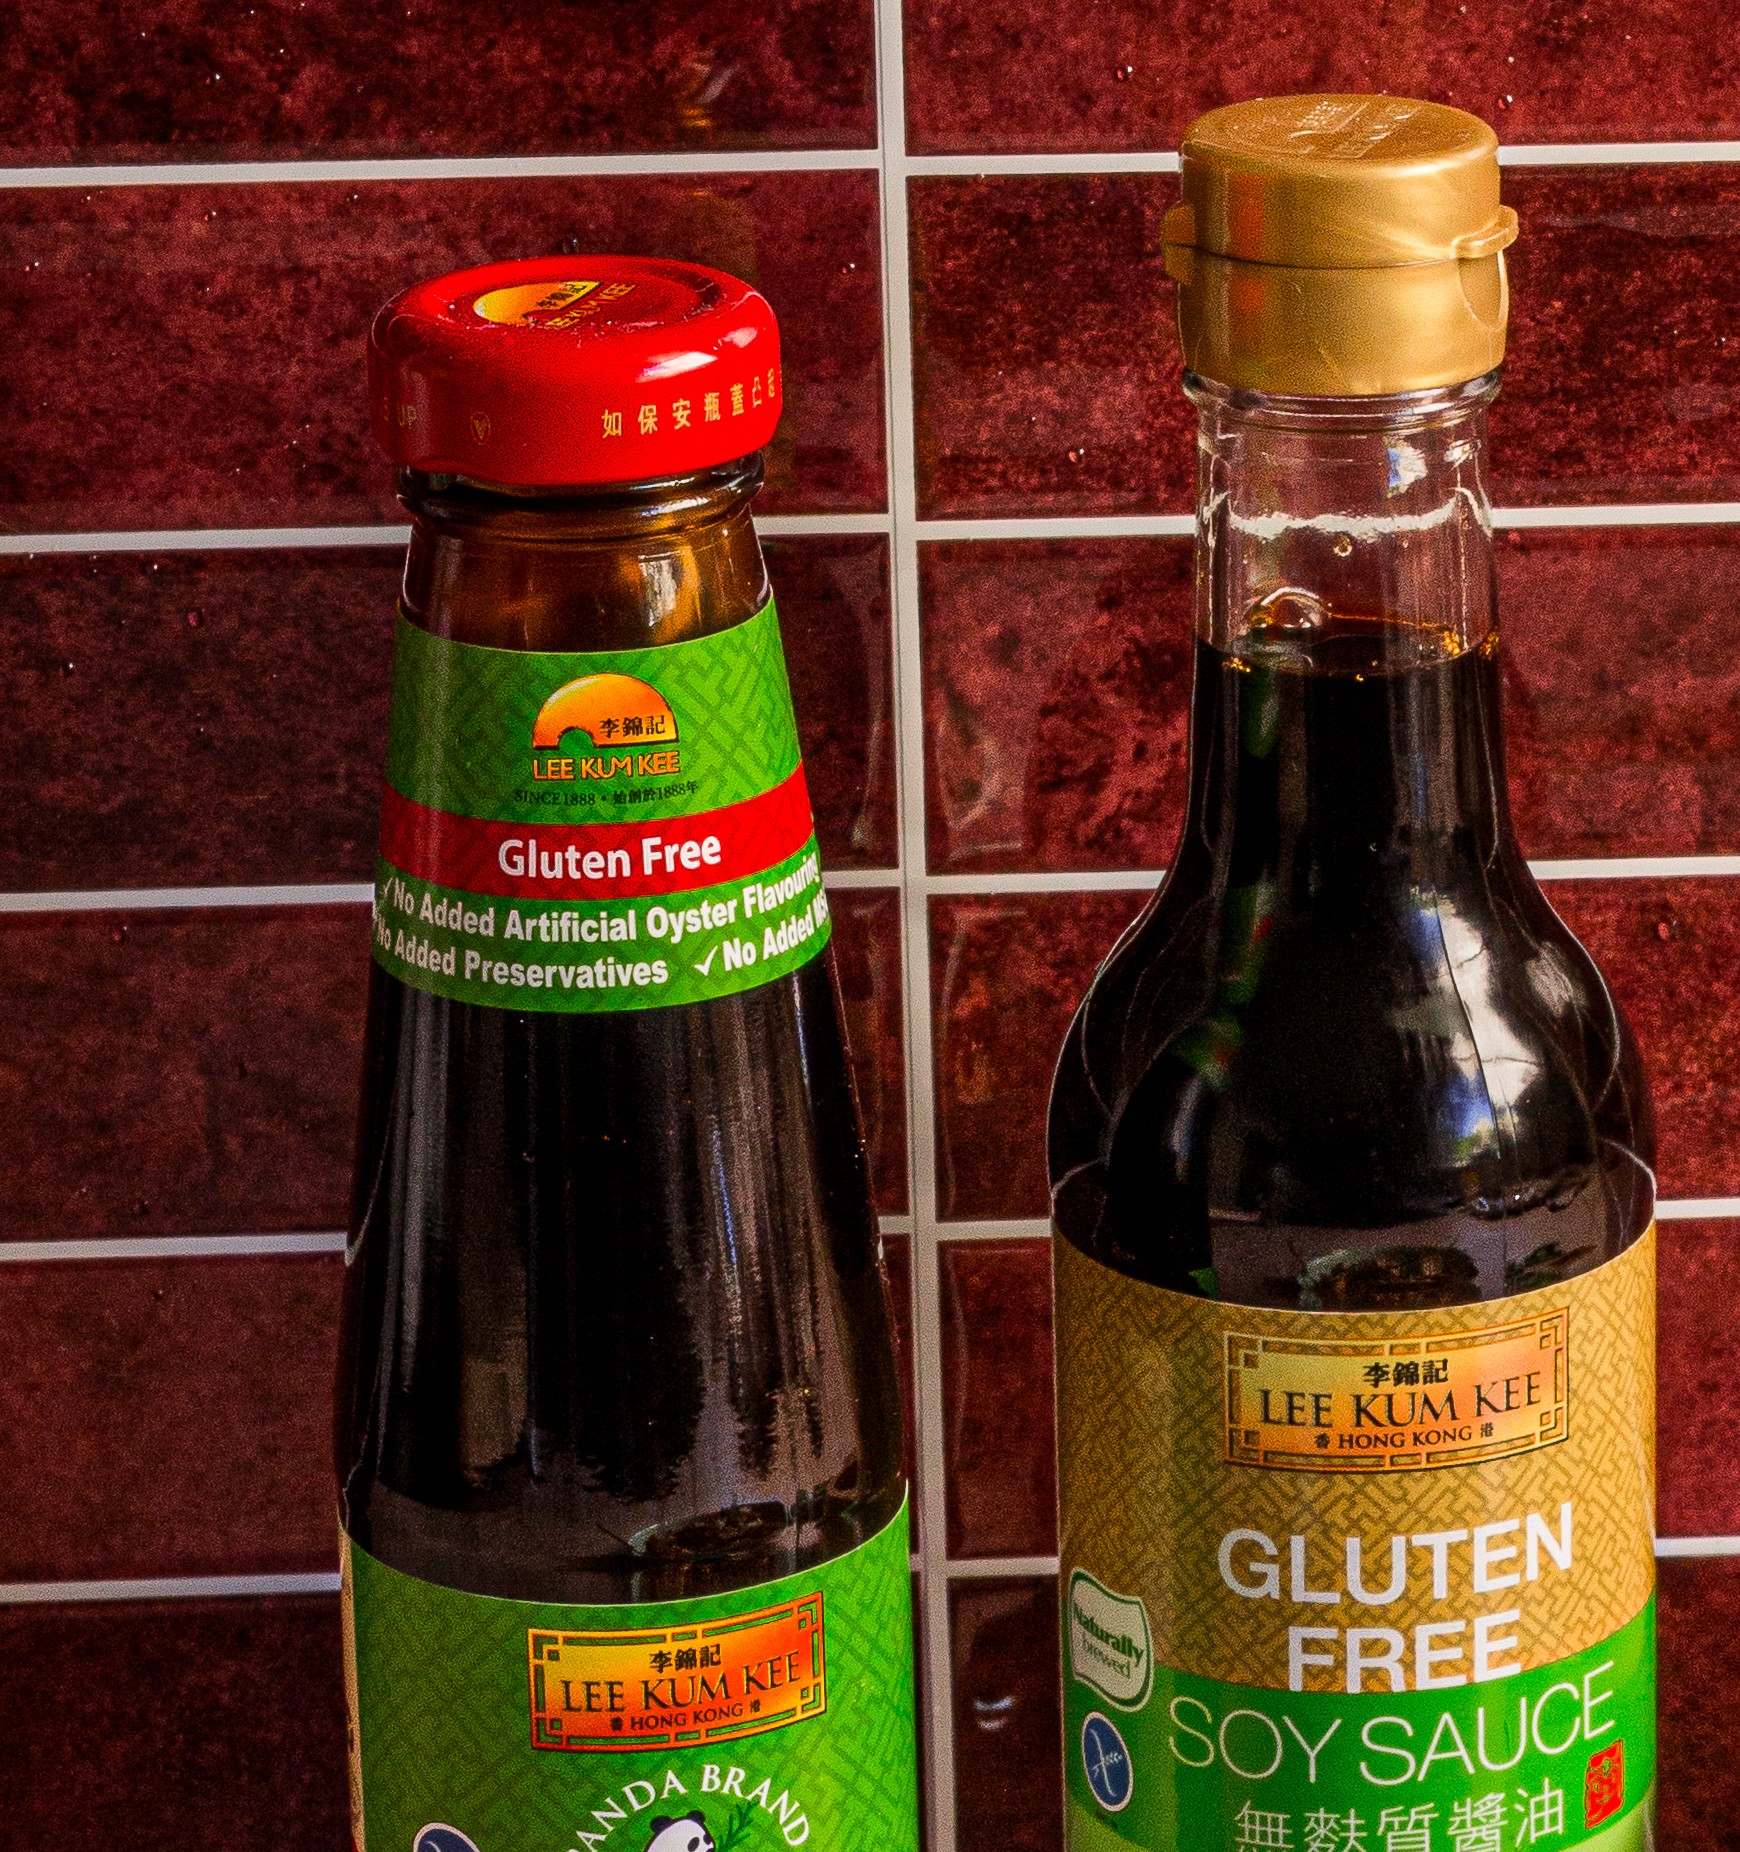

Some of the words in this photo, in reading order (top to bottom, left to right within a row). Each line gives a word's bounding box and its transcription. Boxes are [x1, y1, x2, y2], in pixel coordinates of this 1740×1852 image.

[599, 714, 666, 738] 李錦記
[533, 758, 575, 781] LEE
[581, 754, 633, 779] KUM
[638, 750, 681, 776] KEE
[499, 839, 631, 881] Gluten
[641, 835, 722, 876] Free
[394, 877, 415, 915] No
[419, 892, 495, 938] Added
[504, 909, 636, 944] Artificial
[646, 898, 737, 945] Oyster
[744, 851, 820, 919] Flavouring
[394, 928, 456, 976] Added
[464, 949, 669, 989] Preservatives
[722, 939, 753, 972] No
[763, 904, 815, 958] Added
[1259, 1389, 1333, 1428] LEE
[1350, 1387, 1460, 1428] KUM
[1473, 1371, 1541, 1418] KEE
[1363, 1358, 1449, 1389] 李錦記
[1338, 1432, 1406, 1449] HONG
[1413, 1425, 1473, 1447] KONG
[1217, 1501, 1572, 1606] GLUTEN
[649, 1643, 722, 1674] 李錦記
[1073, 1602, 1144, 1667] Naturally
[1288, 1608, 1523, 1694] FREE
[560, 1679, 625, 1713] LEE
[641, 1670, 731, 1710] KUM
[741, 1651, 801, 1695] KEE
[630, 1713, 686, 1731] HONG
[693, 1702, 743, 1724] KONG
[1168, 1695, 1342, 1784] SOY
[1359, 1660, 1616, 1786] SAUCE
[700, 1764, 810, 1847] BRAND
